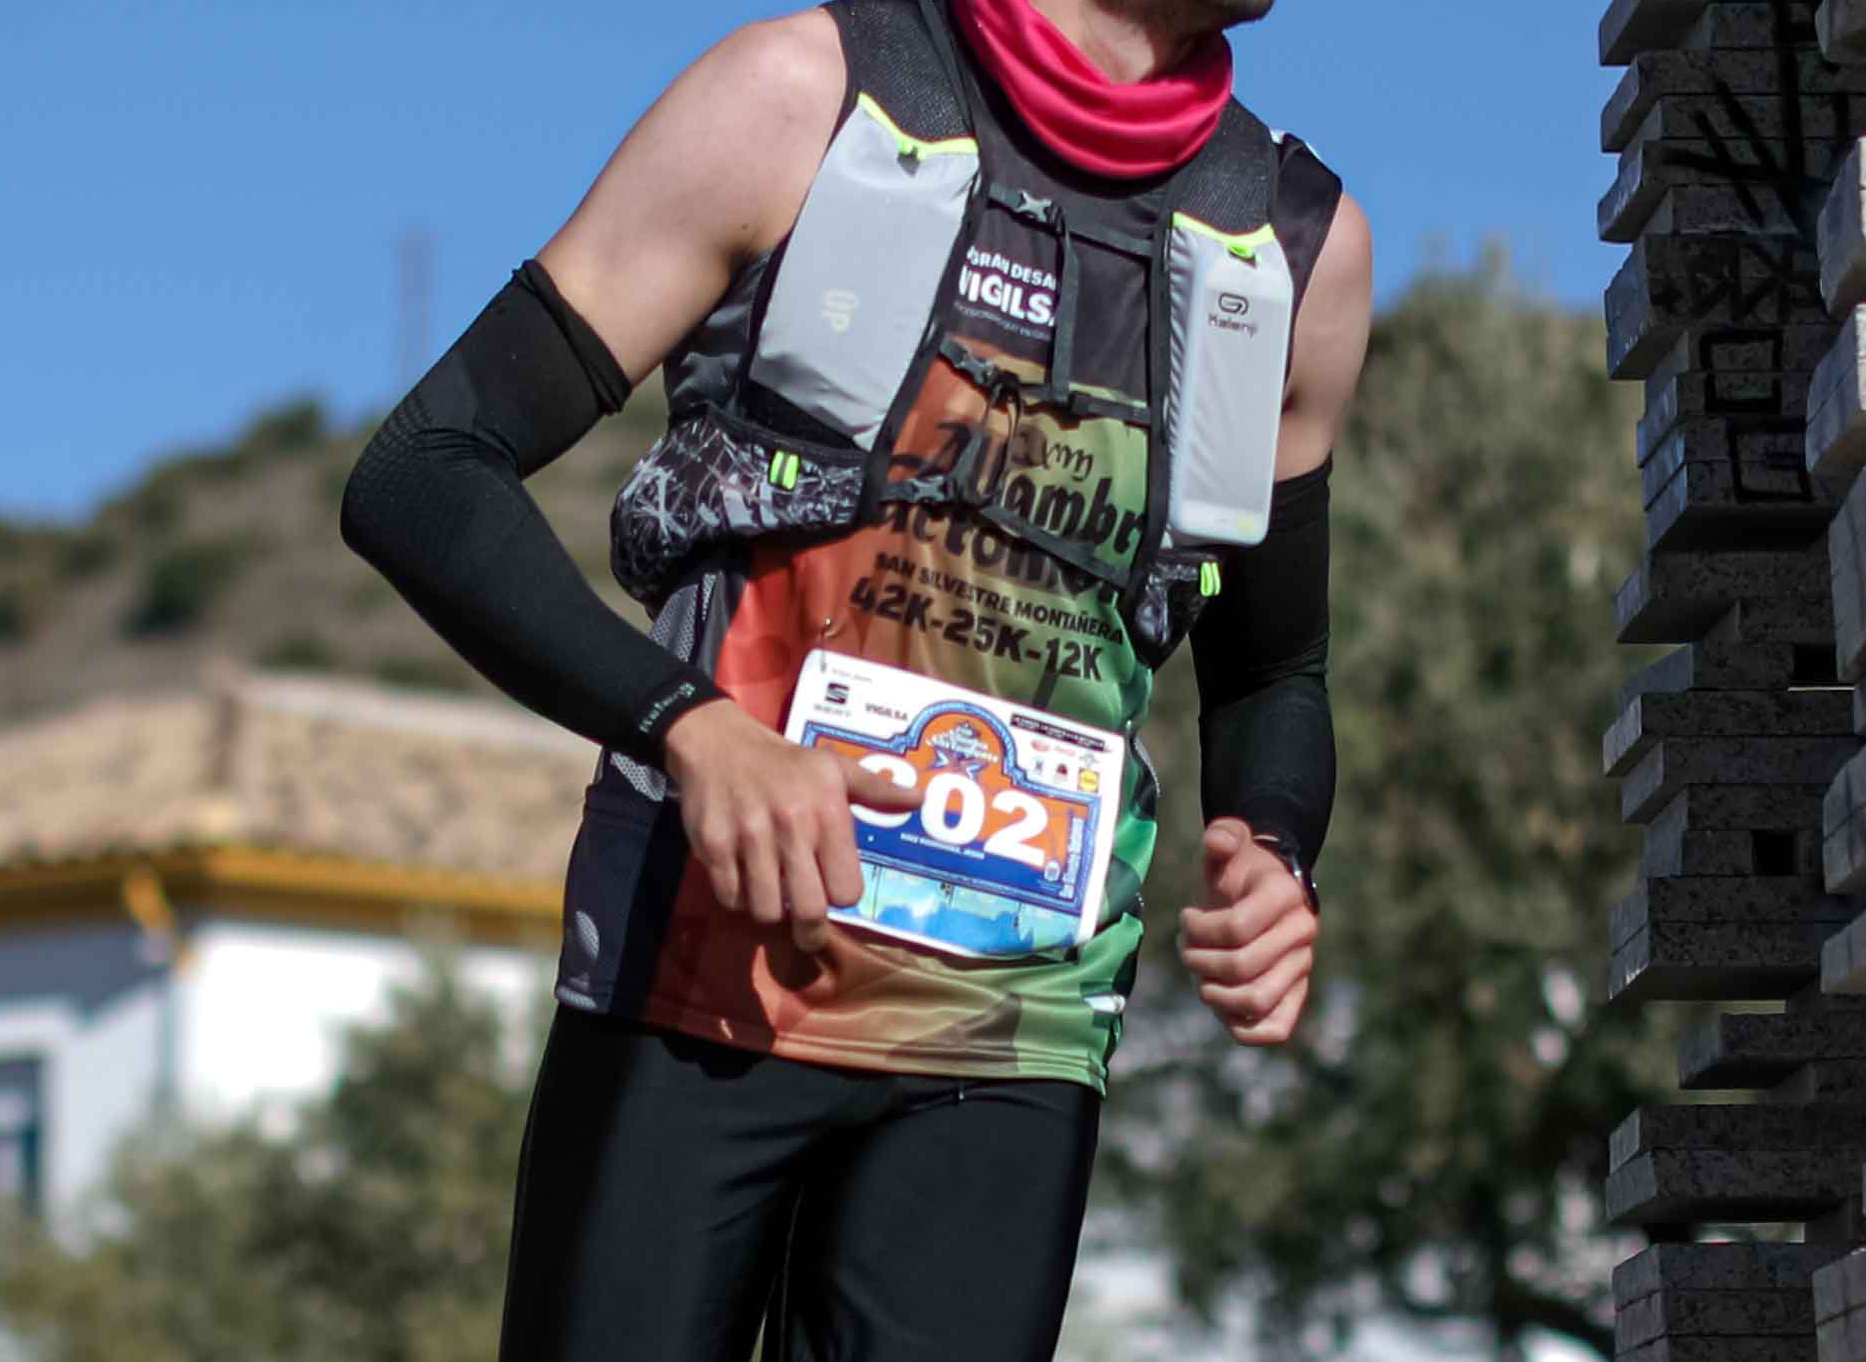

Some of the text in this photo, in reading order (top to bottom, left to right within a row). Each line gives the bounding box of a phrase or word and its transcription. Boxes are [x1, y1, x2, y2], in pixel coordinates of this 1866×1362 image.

[958, 264, 1056, 327] VIGILS
[917, 566, 1011, 615] SILVESTRE
[849, 575, 1106, 684] 42K-25K-12K
